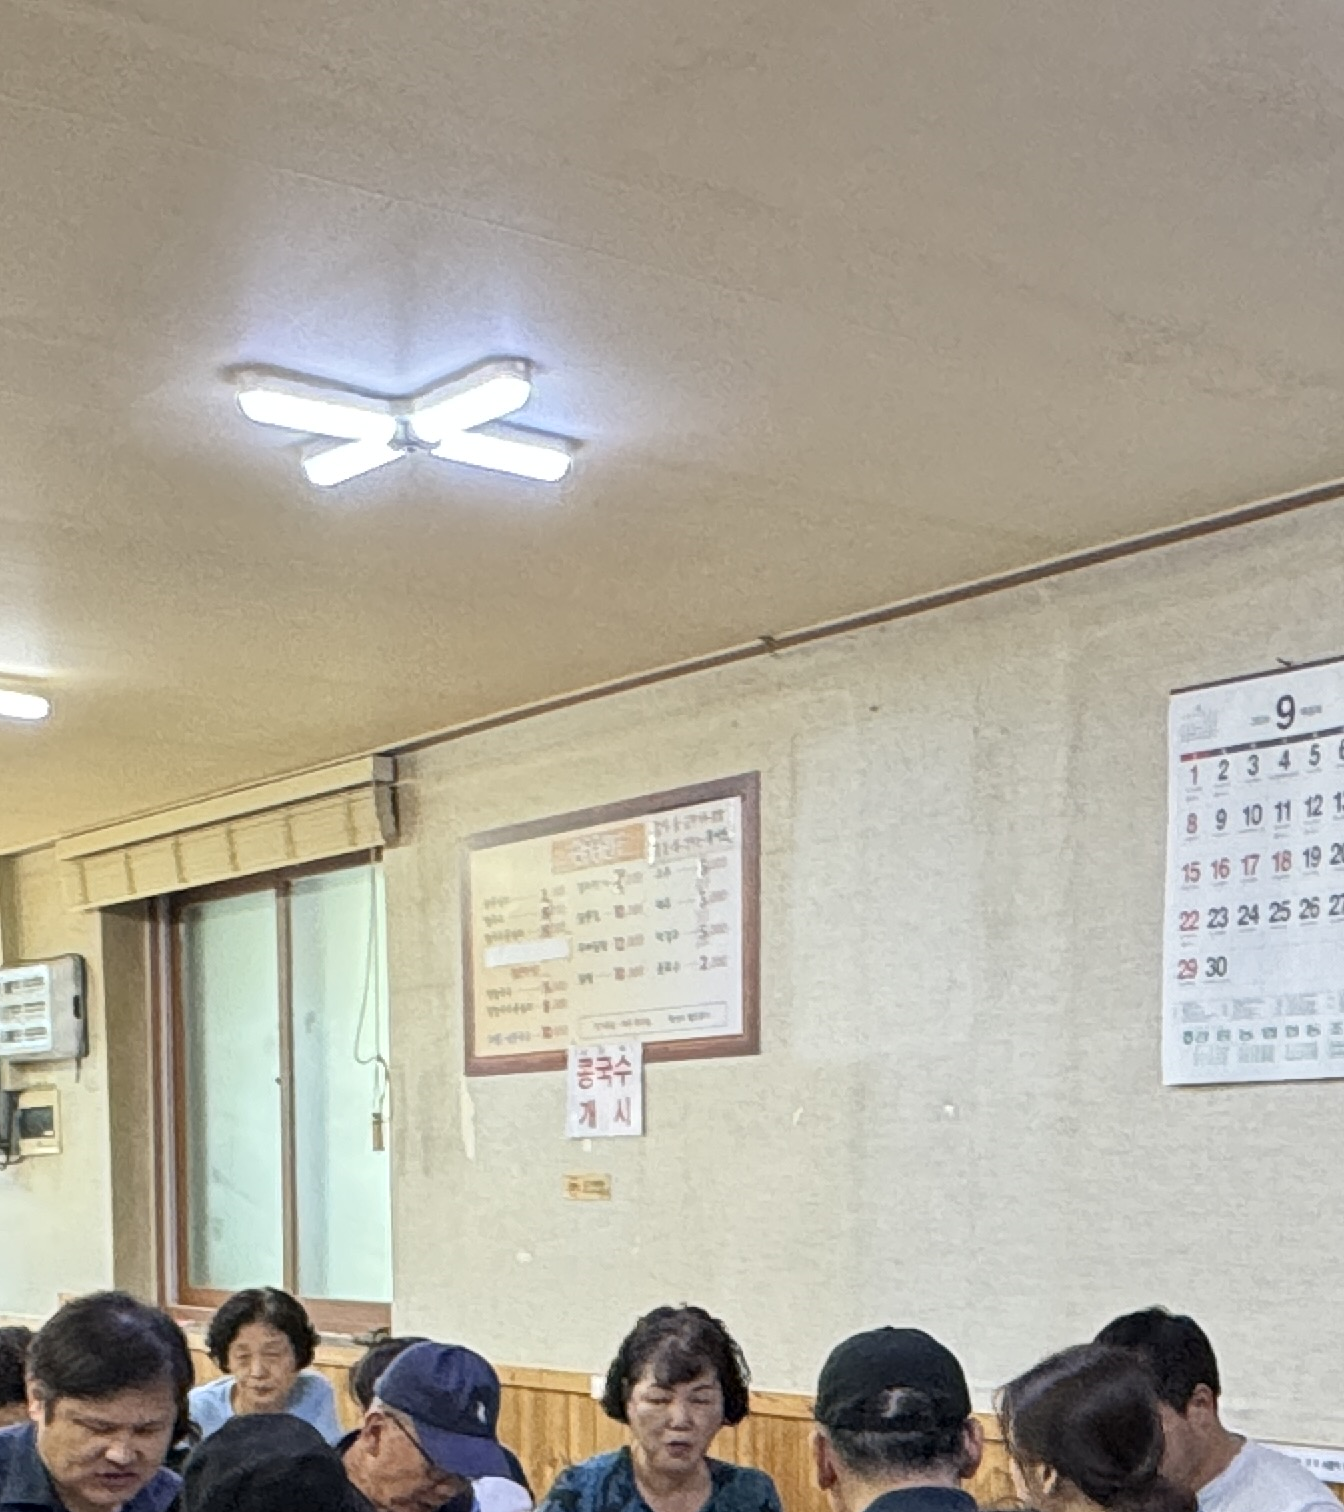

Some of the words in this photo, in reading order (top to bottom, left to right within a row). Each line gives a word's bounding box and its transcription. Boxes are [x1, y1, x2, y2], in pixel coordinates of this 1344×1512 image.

[1276, 694, 1296, 730] 9
[1190, 764, 1198, 786] 1
[1217, 759, 1230, 782] 2
[1247, 754, 1260, 776] 3
[1278, 749, 1291, 771] 4
[1308, 743, 1321, 767] 5
[1186, 812, 1198, 834] 8
[1215, 808, 1228, 831] 9
[1242, 803, 1263, 826] 10
[1274, 799, 1291, 823] 11
[1304, 794, 1324, 818] 12
[1181, 861, 1201, 883] 15
[1210, 857, 1230, 880] 16
[1240, 853, 1261, 876] 17
[1271, 849, 1292, 872] 18
[1302, 845, 1322, 868] 19
[1179, 910, 1200, 932] 22
[1206, 906, 1229, 929] 23
[1237, 904, 1260, 926] 24
[1268, 900, 1292, 924] 25
[1298, 896, 1320, 920] 26
[1176, 958, 1198, 980] 29
[1205, 956, 1228, 978] 30
[577, 1055, 633, 1090] 콩국수
